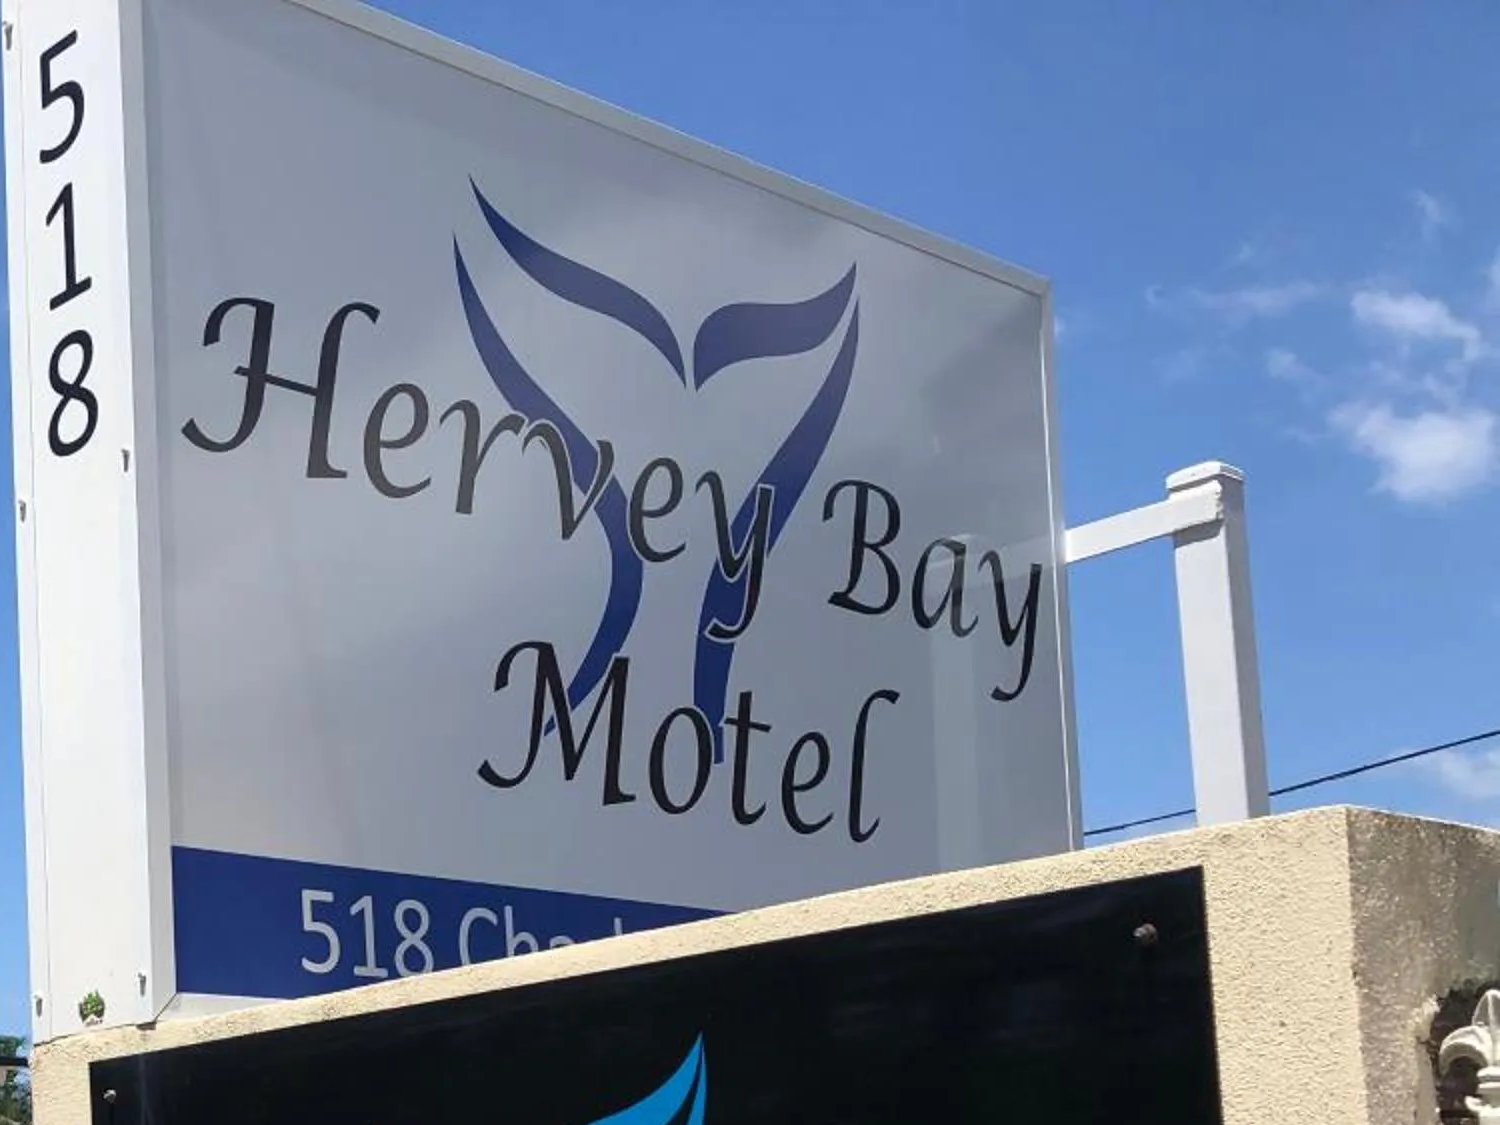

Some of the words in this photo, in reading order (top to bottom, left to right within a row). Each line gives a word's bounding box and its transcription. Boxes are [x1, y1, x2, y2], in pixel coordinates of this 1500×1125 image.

[38, 29, 98, 458] 518
[181, 297, 776, 641] Hervey
[821, 480, 1043, 702] Bay
[477, 641, 900, 844] Motel
[300, 888, 435, 978] 518
